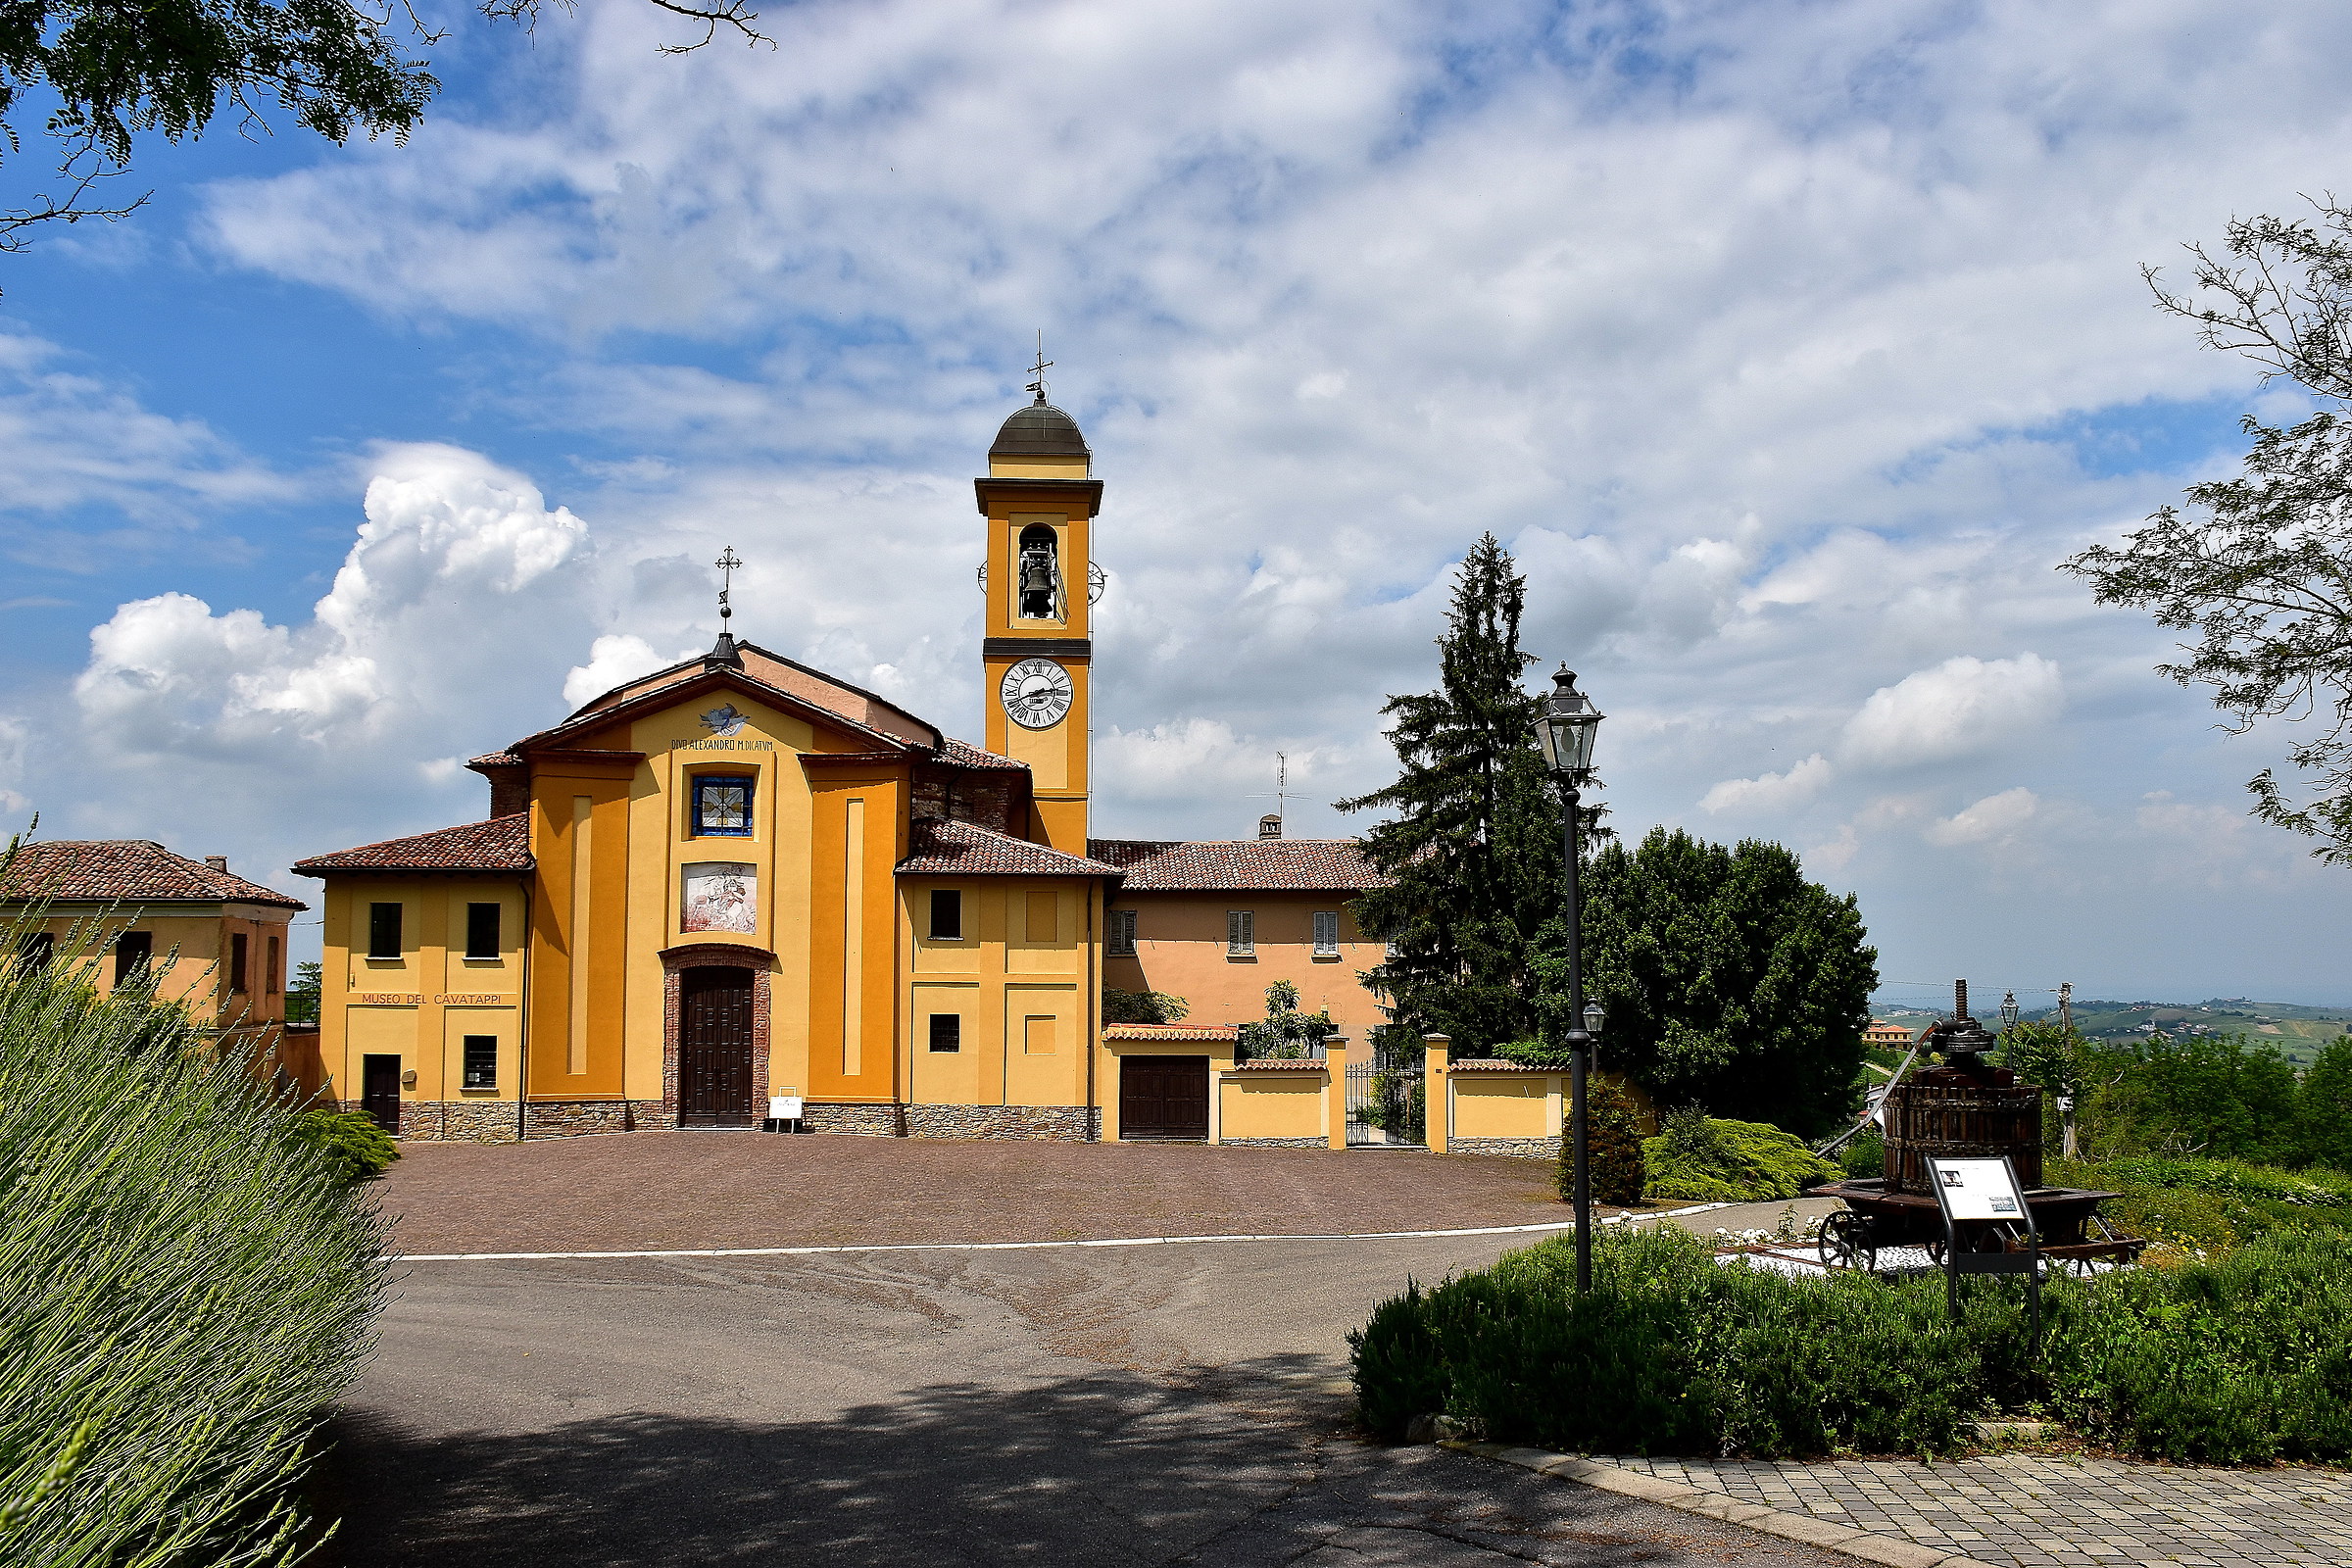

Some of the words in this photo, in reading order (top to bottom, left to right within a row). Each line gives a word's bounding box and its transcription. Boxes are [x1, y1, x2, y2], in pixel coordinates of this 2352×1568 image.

[688, 739, 735, 751] ALEXANDRO
[362, 994, 401, 1004] MUSEO
[407, 994, 427, 1004] DEL
[434, 994, 501, 1004] CAVATAPPI
